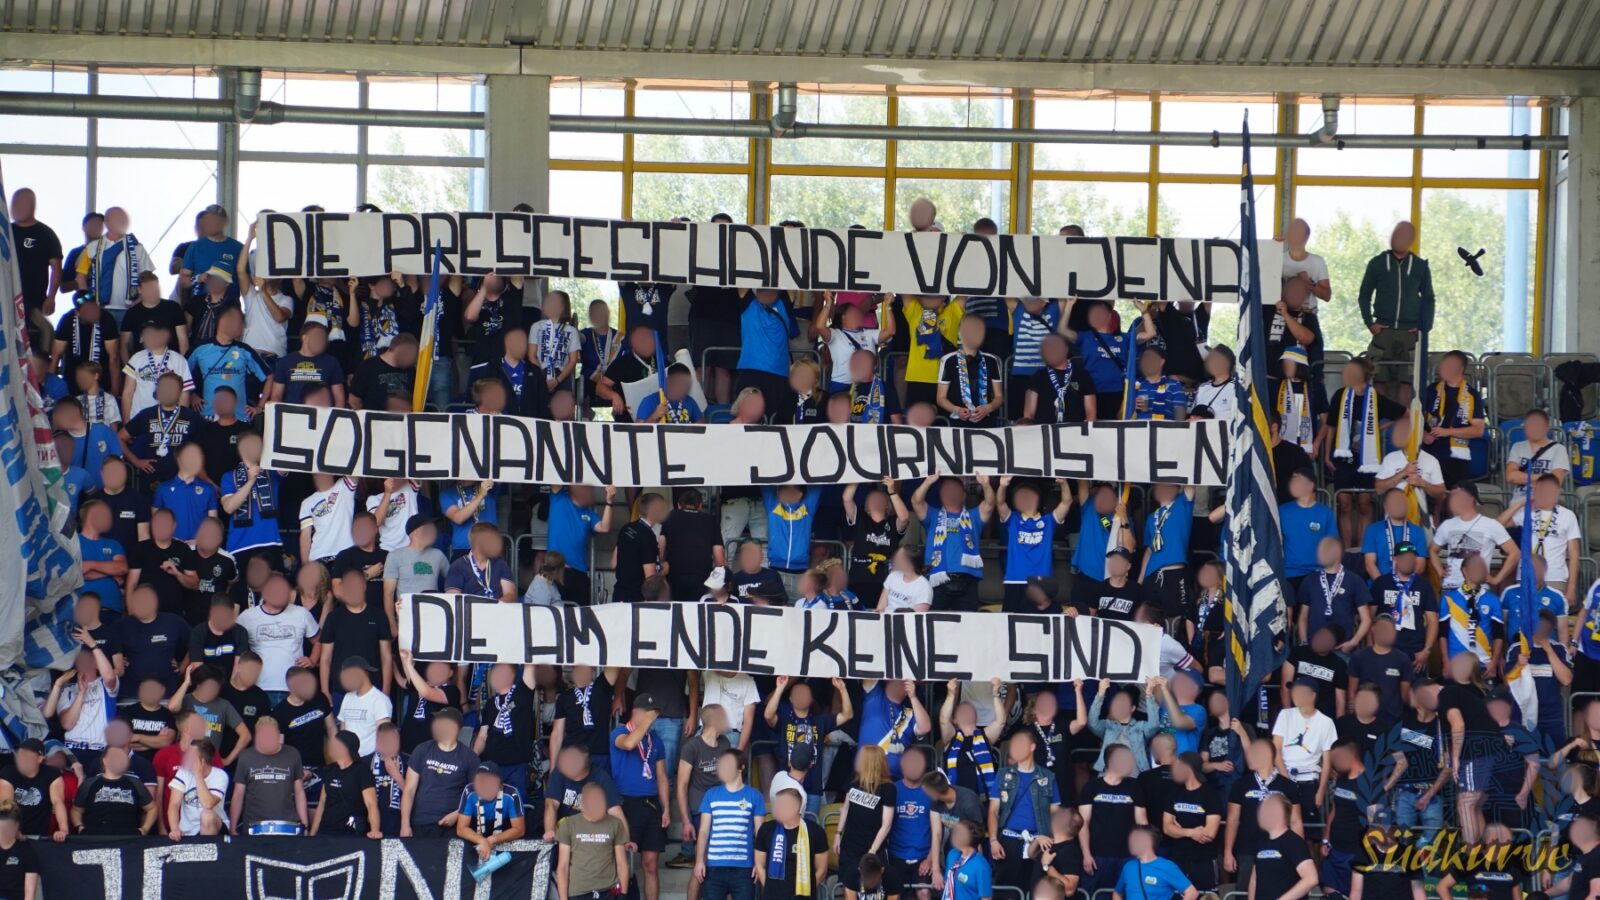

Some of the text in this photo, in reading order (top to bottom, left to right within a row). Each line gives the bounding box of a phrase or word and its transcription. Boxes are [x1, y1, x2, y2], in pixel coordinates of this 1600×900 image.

[266, 211, 1240, 301] DIE PRESSESCHANDE VON JENA
[270, 402, 1229, 486] SOGENANNTE JOURNALISTEN
[411, 593, 1142, 681] DIE AM ENDE KEINE SIND
